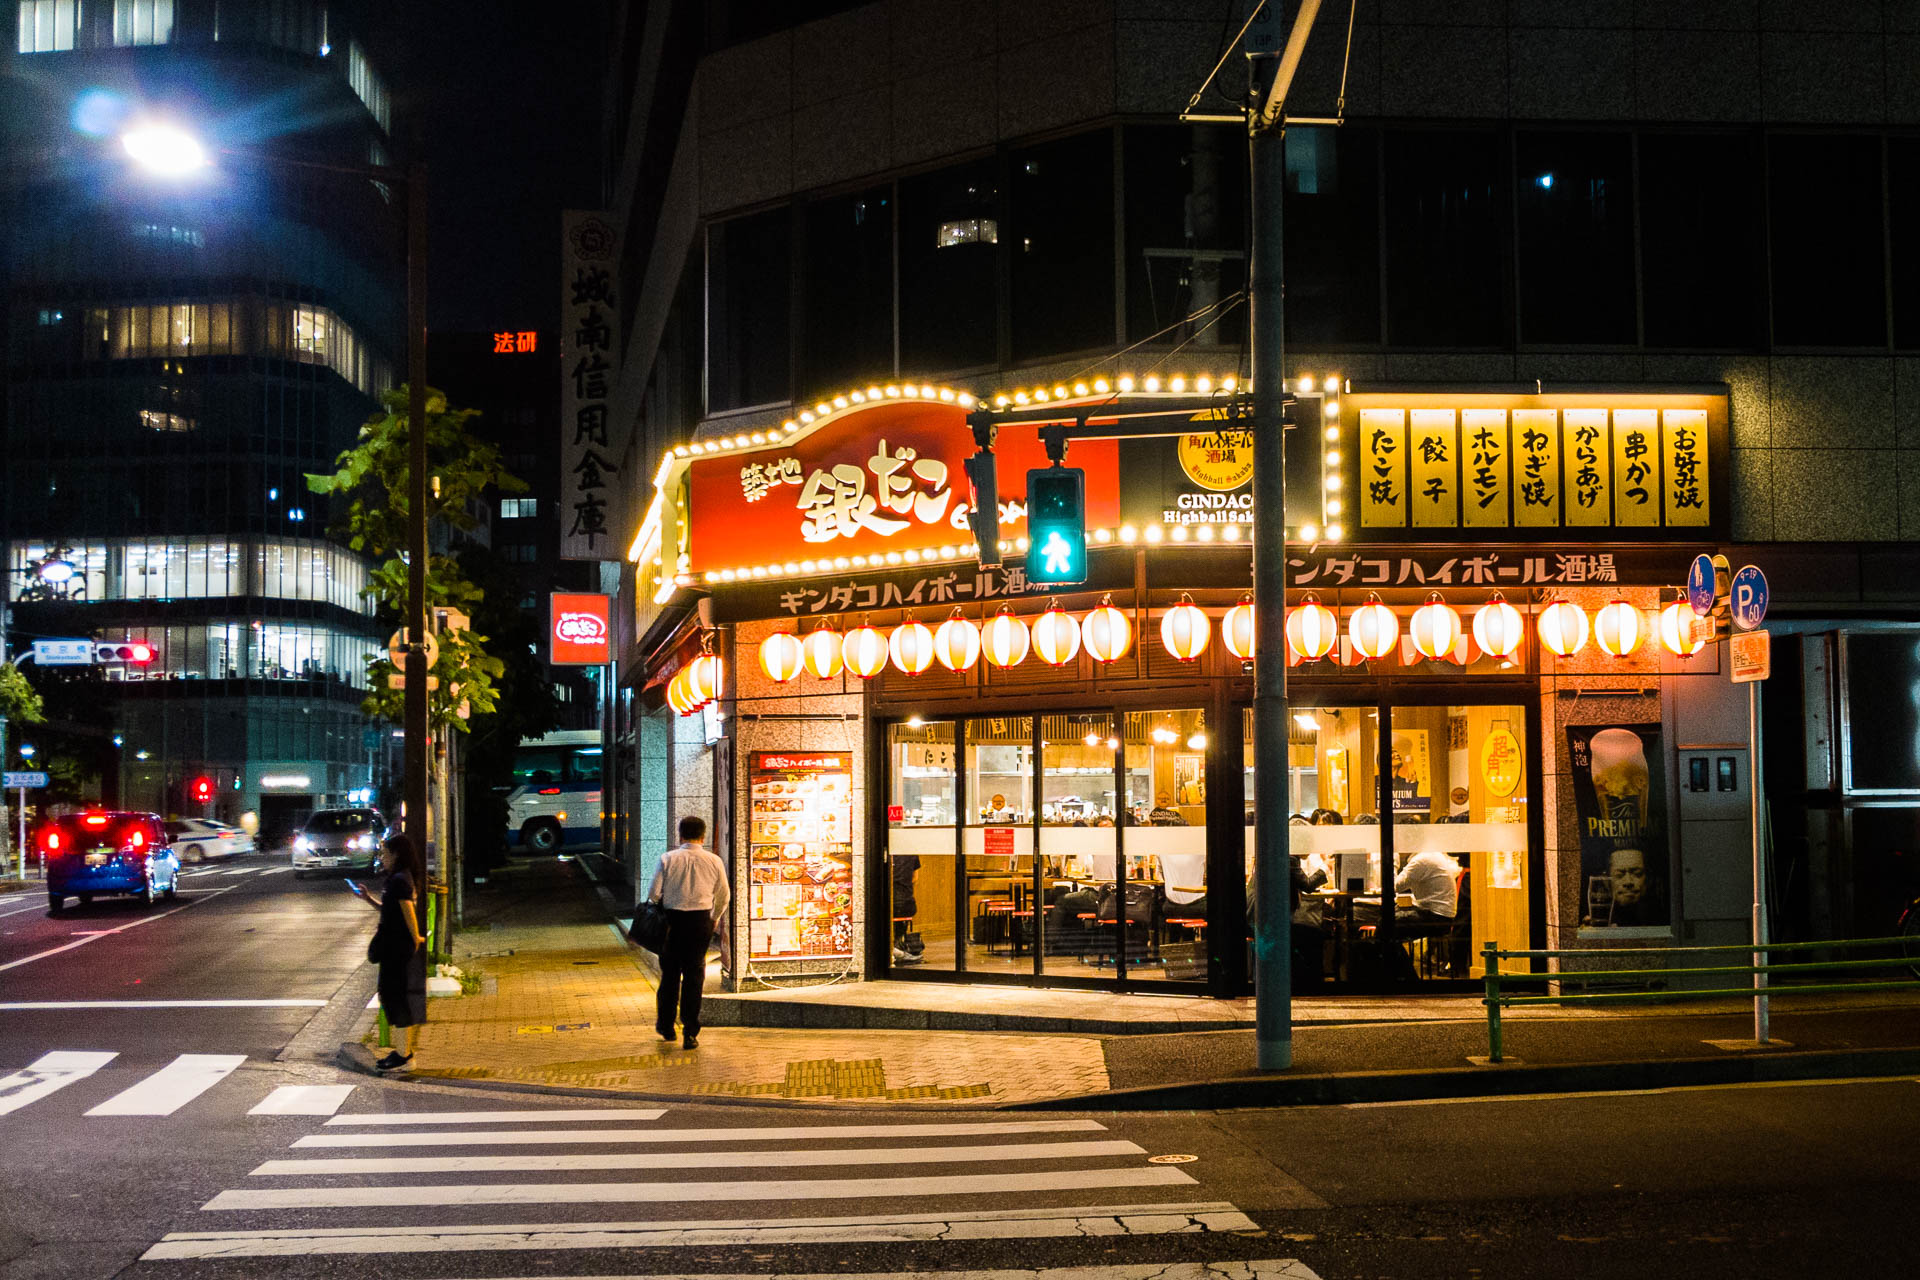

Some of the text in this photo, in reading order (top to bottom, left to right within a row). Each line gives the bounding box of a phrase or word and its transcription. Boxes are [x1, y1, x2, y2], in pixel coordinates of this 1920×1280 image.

[493, 331, 537, 353] 法研
[569, 265, 618, 550] 城南信用金庫
[741, 438, 952, 543] 築地 銀だこ
[1205, 449, 1236, 464] 酒場
[1369, 429, 1400, 506] たこ焼
[1418, 436, 1448, 504] 餃子
[1471, 427, 1501, 509] ホルモン
[1521, 428, 1554, 507] ねぎ焼
[1575, 426, 1603, 508] からあげ
[1624, 430, 1651, 505] 串かつ
[1673, 427, 1704, 509] お好み焼
[1163, 510, 1254, 525] Highball Sak
[1252, 553, 1618, 585] ンダコハイボール酒場
[1738, 585, 1753, 622] P
[924, 748, 955, 765] たこ
[1573, 740, 1588, 768] 神泡
